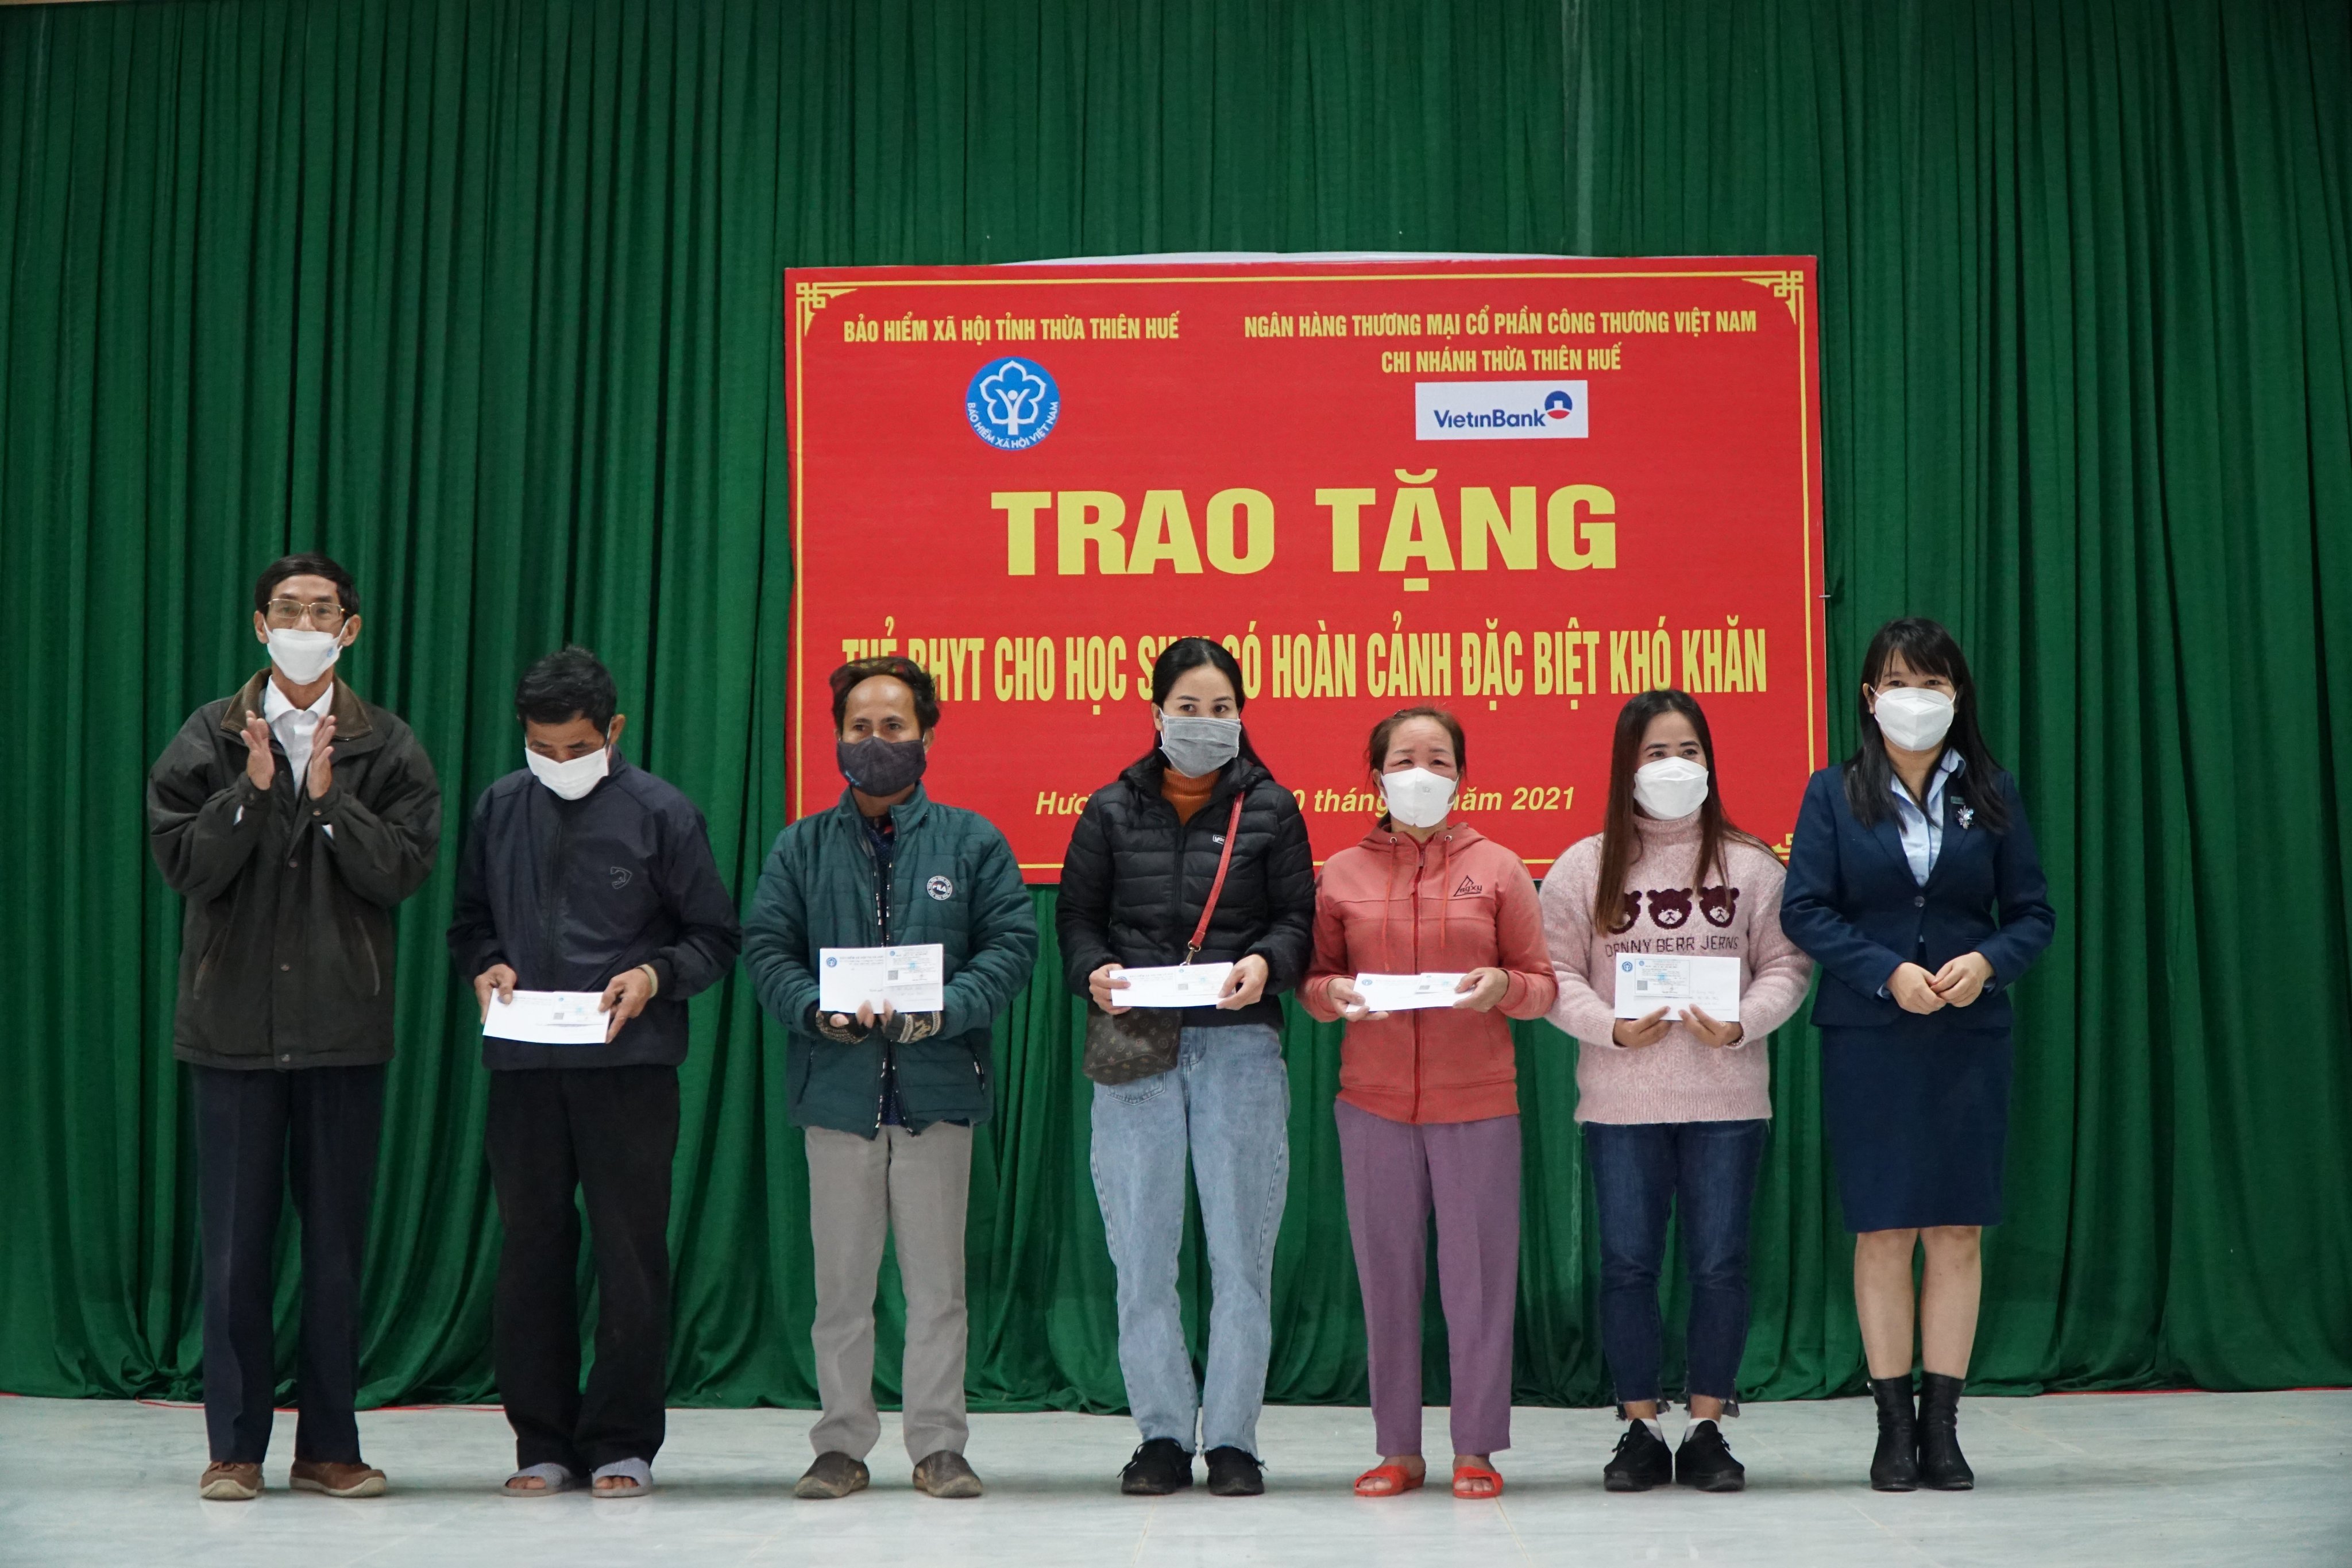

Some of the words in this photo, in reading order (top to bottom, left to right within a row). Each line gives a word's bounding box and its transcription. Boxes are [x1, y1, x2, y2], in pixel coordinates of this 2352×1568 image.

[844, 314, 879, 342] BẢO
[884, 312, 928, 341] HIỂM
[933, 316, 956, 341] XÃ
[962, 315, 991, 345] HỘI
[997, 312, 1036, 340] TỈNH
[1040, 314, 1085, 340] THỪA
[1090, 314, 1141, 339] THIÊN
[1146, 311, 1179, 338] HUẾ
[1245, 312, 1293, 337] NGÂN
[1299, 310, 1347, 337] HÀNG
[1353, 314, 1422, 336] THƯƠNG
[1427, 314, 1460, 339] MẠI
[1466, 305, 1489, 335] CỔ
[1494, 306, 1542, 334] PHẦN
[1547, 308, 1595, 334] CÔNG
[1601, 310, 1669, 333] THƯƠNG
[1675, 307, 1710, 337] VIỆT
[1716, 310, 1756, 332] NAM
[1382, 352, 1411, 373] CHI
[1416, 346, 1477, 372] NHÁNH
[1482, 345, 1527, 371] THỪA
[1531, 345, 1582, 370] THIÊN
[1588, 341, 1621, 370] HUẾ
[995, 437, 1010, 448] XÃ
[1045, 401, 1059, 424] NAM
[1433, 409, 1546, 427] VietinBank
[991, 487, 1275, 576] TRAO
[1315, 468, 1616, 592] TẶNG
[994, 636, 1056, 701] CHO
[1065, 636, 1127, 715] HỌC
[1272, 620, 1356, 698] HOÀN
[1367, 611, 1451, 696] CẢNH
[1461, 618, 1523, 710] ĐẶC
[1534, 617, 1600, 710] BIỆT
[1610, 616, 1671, 694] KHÓ
[1682, 615, 1767, 694] KHĂN
[1036, 791, 1092, 815] Hươ
[1314, 787, 1388, 818] tháng
[1511, 786, 1574, 810] 2021
[932, 883, 947, 893] FILA
